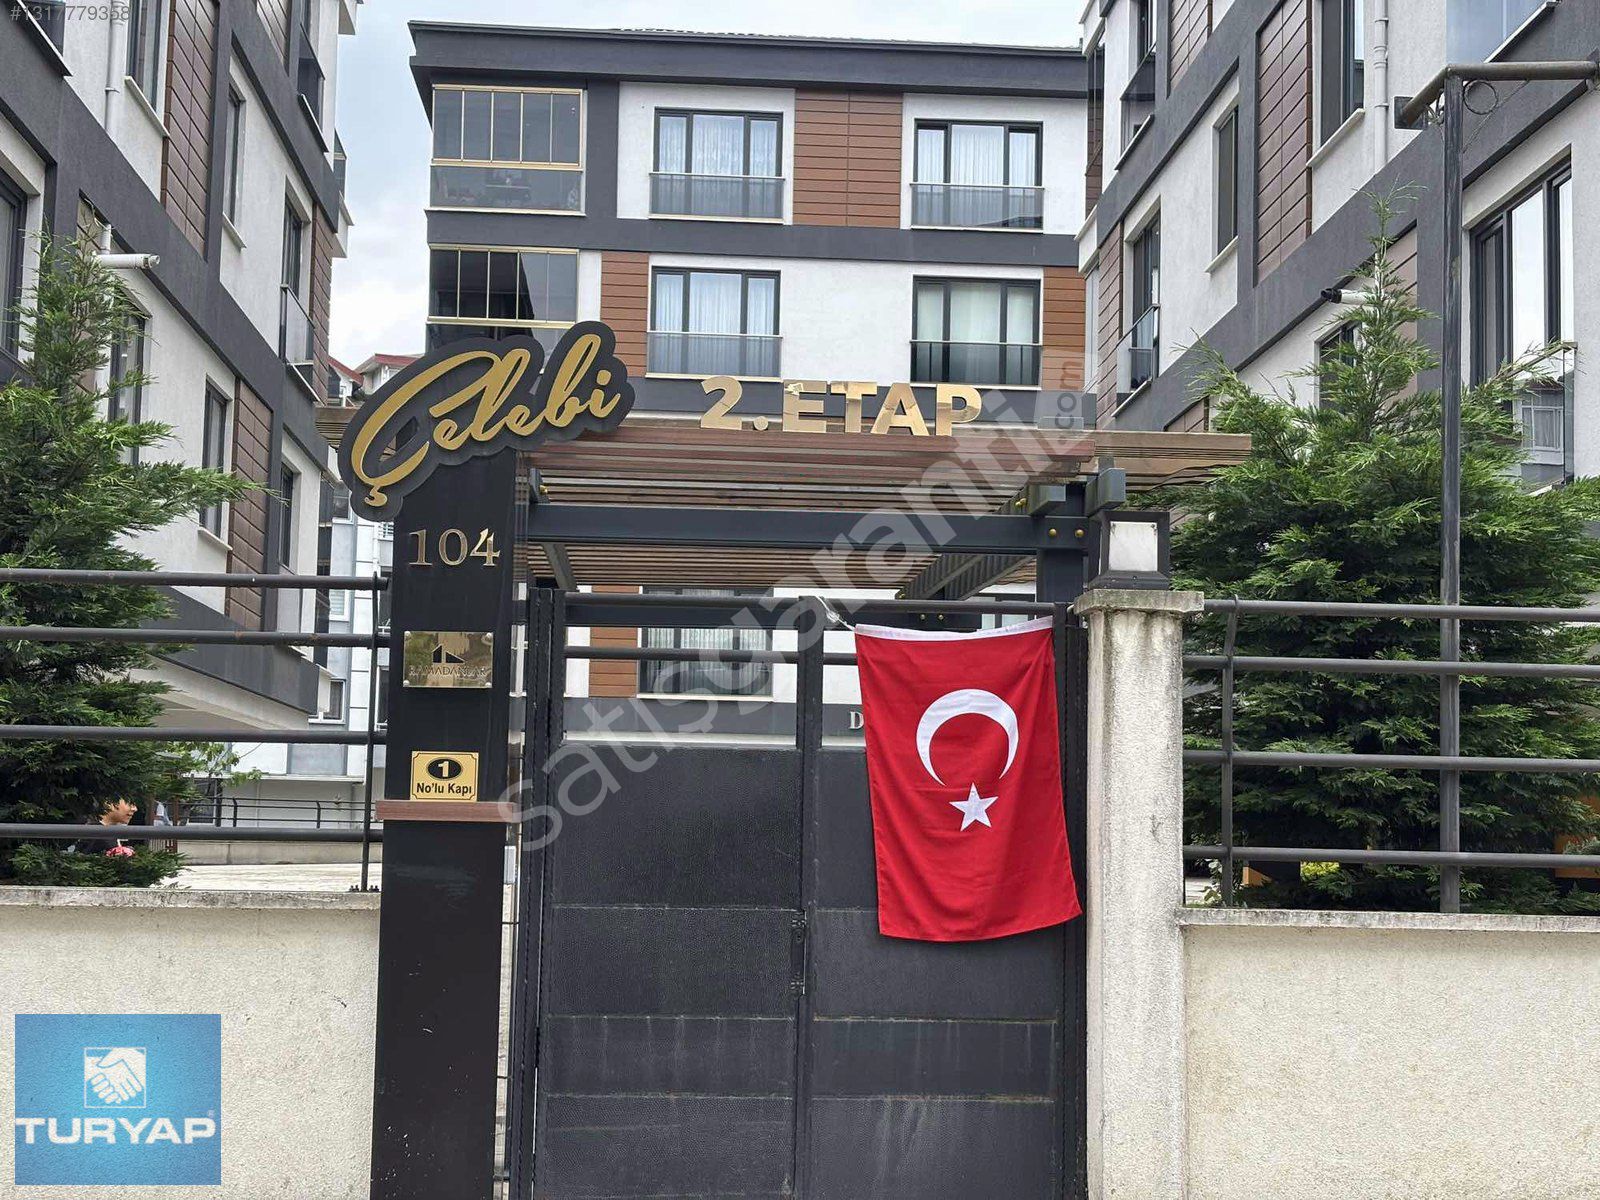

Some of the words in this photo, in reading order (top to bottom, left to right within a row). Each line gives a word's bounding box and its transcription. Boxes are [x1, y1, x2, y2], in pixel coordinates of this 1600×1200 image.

[351, 333, 621, 507] Çelebi
[700, 376, 769, 431] 2.
[782, 380, 983, 436] ETAP
[408, 527, 501, 567] 104
[416, 782, 444, 794] No'lu
[448, 783, 472, 796] Kapı
[437, 760, 450, 778] 1
